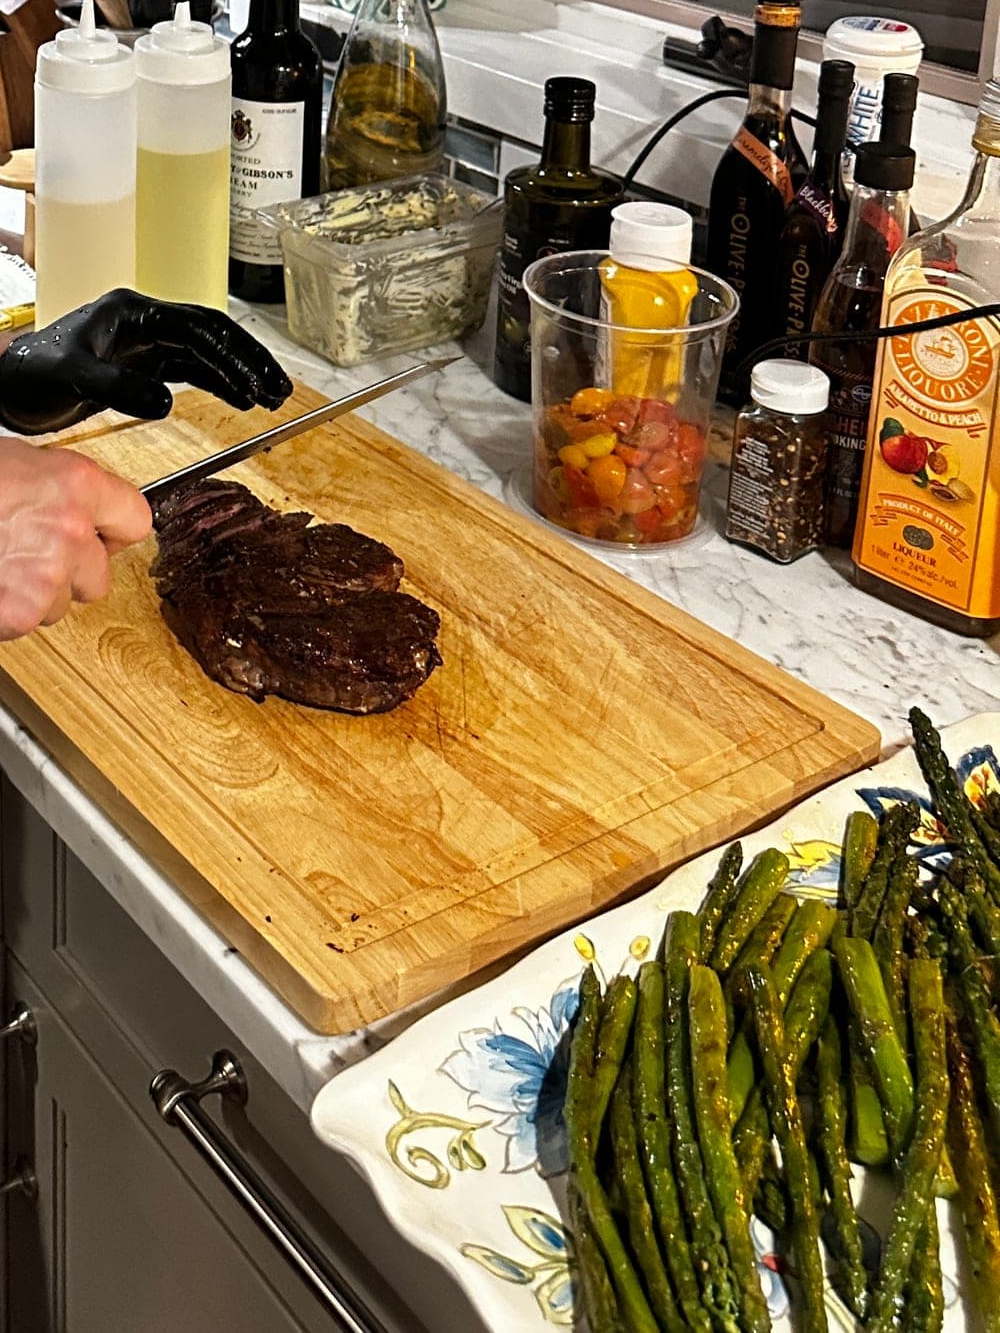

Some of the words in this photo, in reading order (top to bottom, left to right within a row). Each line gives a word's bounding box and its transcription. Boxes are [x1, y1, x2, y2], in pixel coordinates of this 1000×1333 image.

[847, 85, 880, 145] WHITE
[788, 259, 810, 314] OLIVE
[895, 352, 985, 401] LIQUORE
[949, 412, 982, 426] PEACH
[883, 498, 920, 515] PRODUCT
[922, 510, 934, 520] OF
[935, 516, 961, 536] ITALY
[893, 542, 937, 567] LIQUEUR
